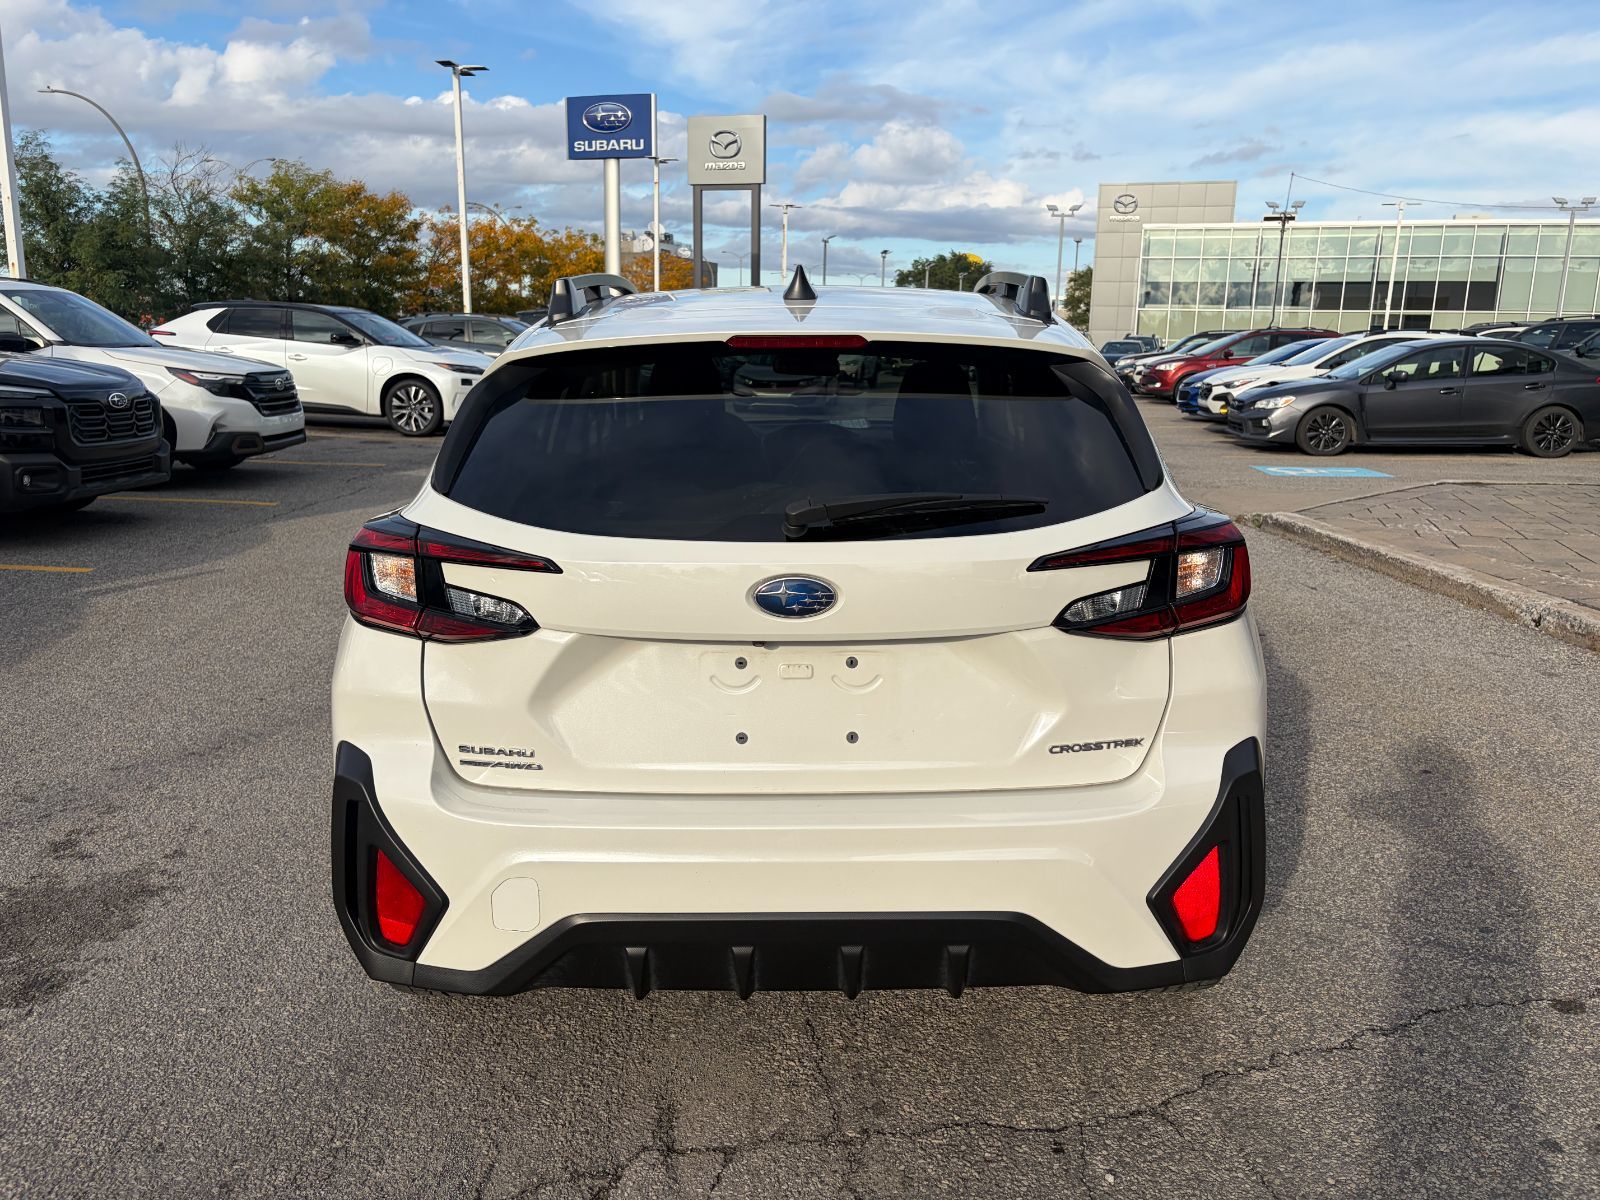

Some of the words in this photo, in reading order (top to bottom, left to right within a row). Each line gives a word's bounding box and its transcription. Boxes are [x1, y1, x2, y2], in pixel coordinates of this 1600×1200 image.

[573, 139, 645, 152] SUBARU
[704, 161, 746, 171] mazda
[458, 744, 536, 758] SUBARU
[1049, 738, 1144, 755] CROSSTREK
